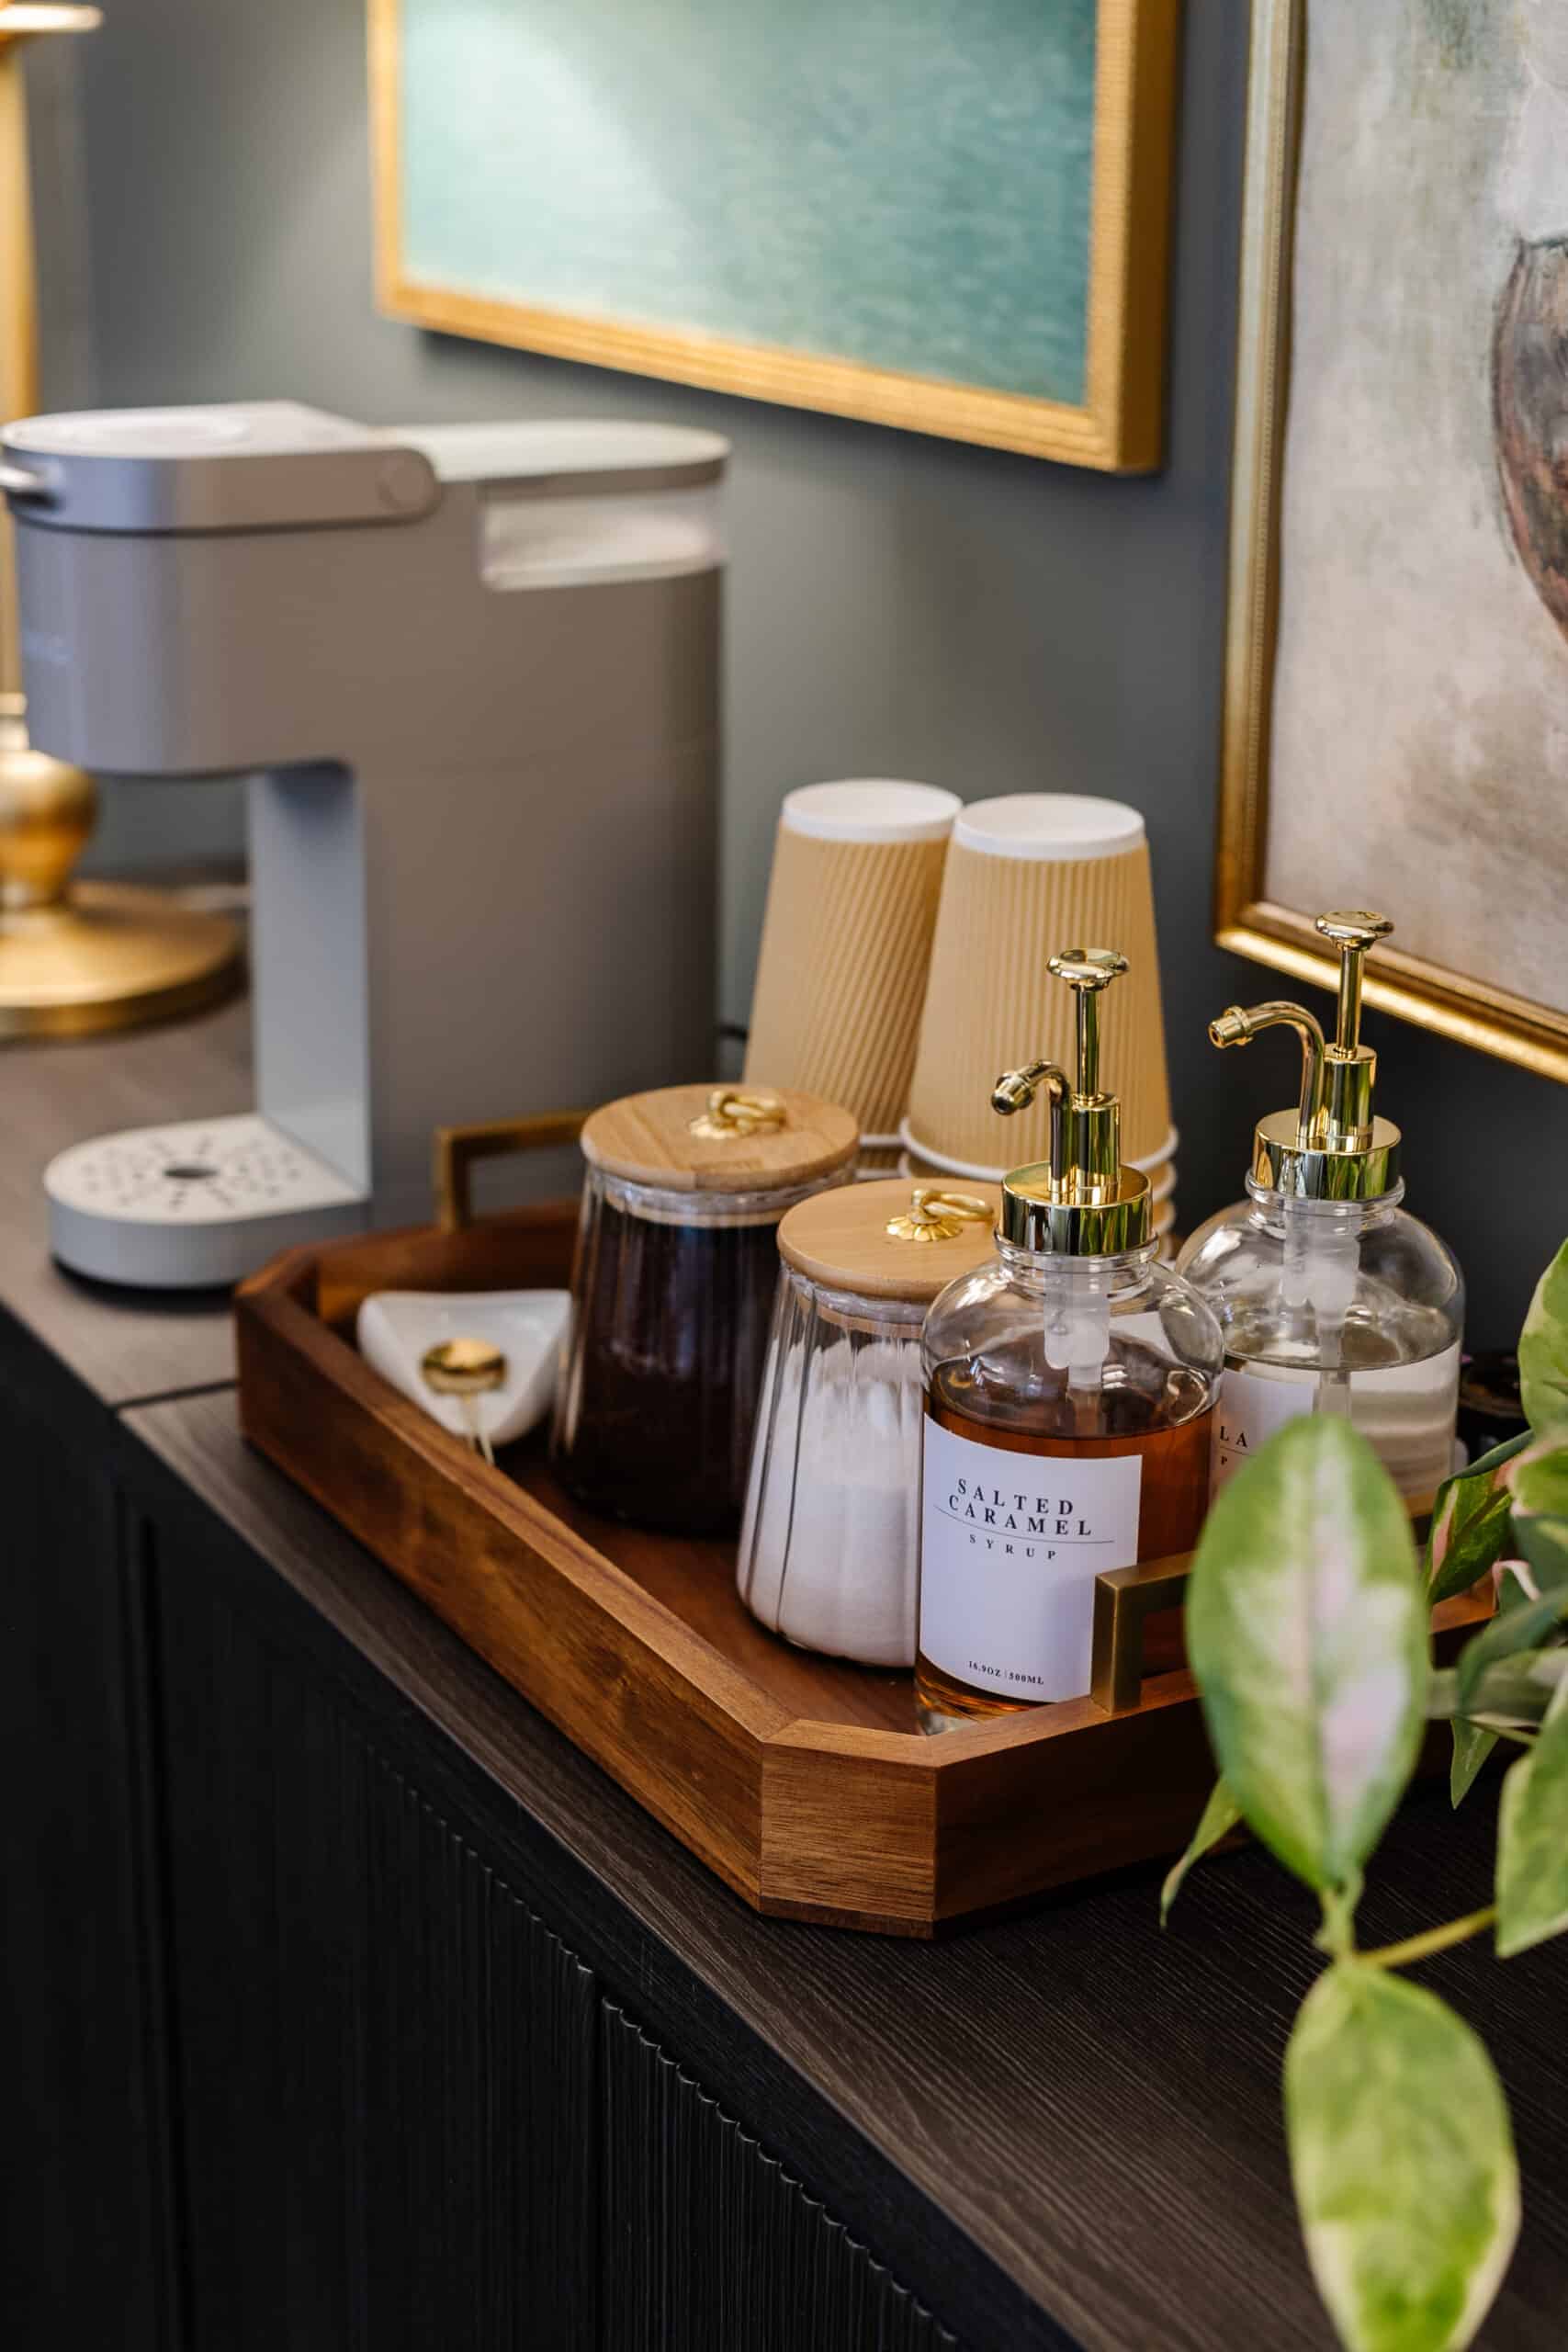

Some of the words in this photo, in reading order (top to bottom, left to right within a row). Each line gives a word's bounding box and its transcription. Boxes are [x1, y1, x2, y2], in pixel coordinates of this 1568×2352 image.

[957, 1477, 1073, 1515] SALTED
[949, 1494, 1091, 1535] CARAMEL
[970, 1533, 1055, 1560] SYRUP
[1009, 1671, 1044, 1685] 500ML
